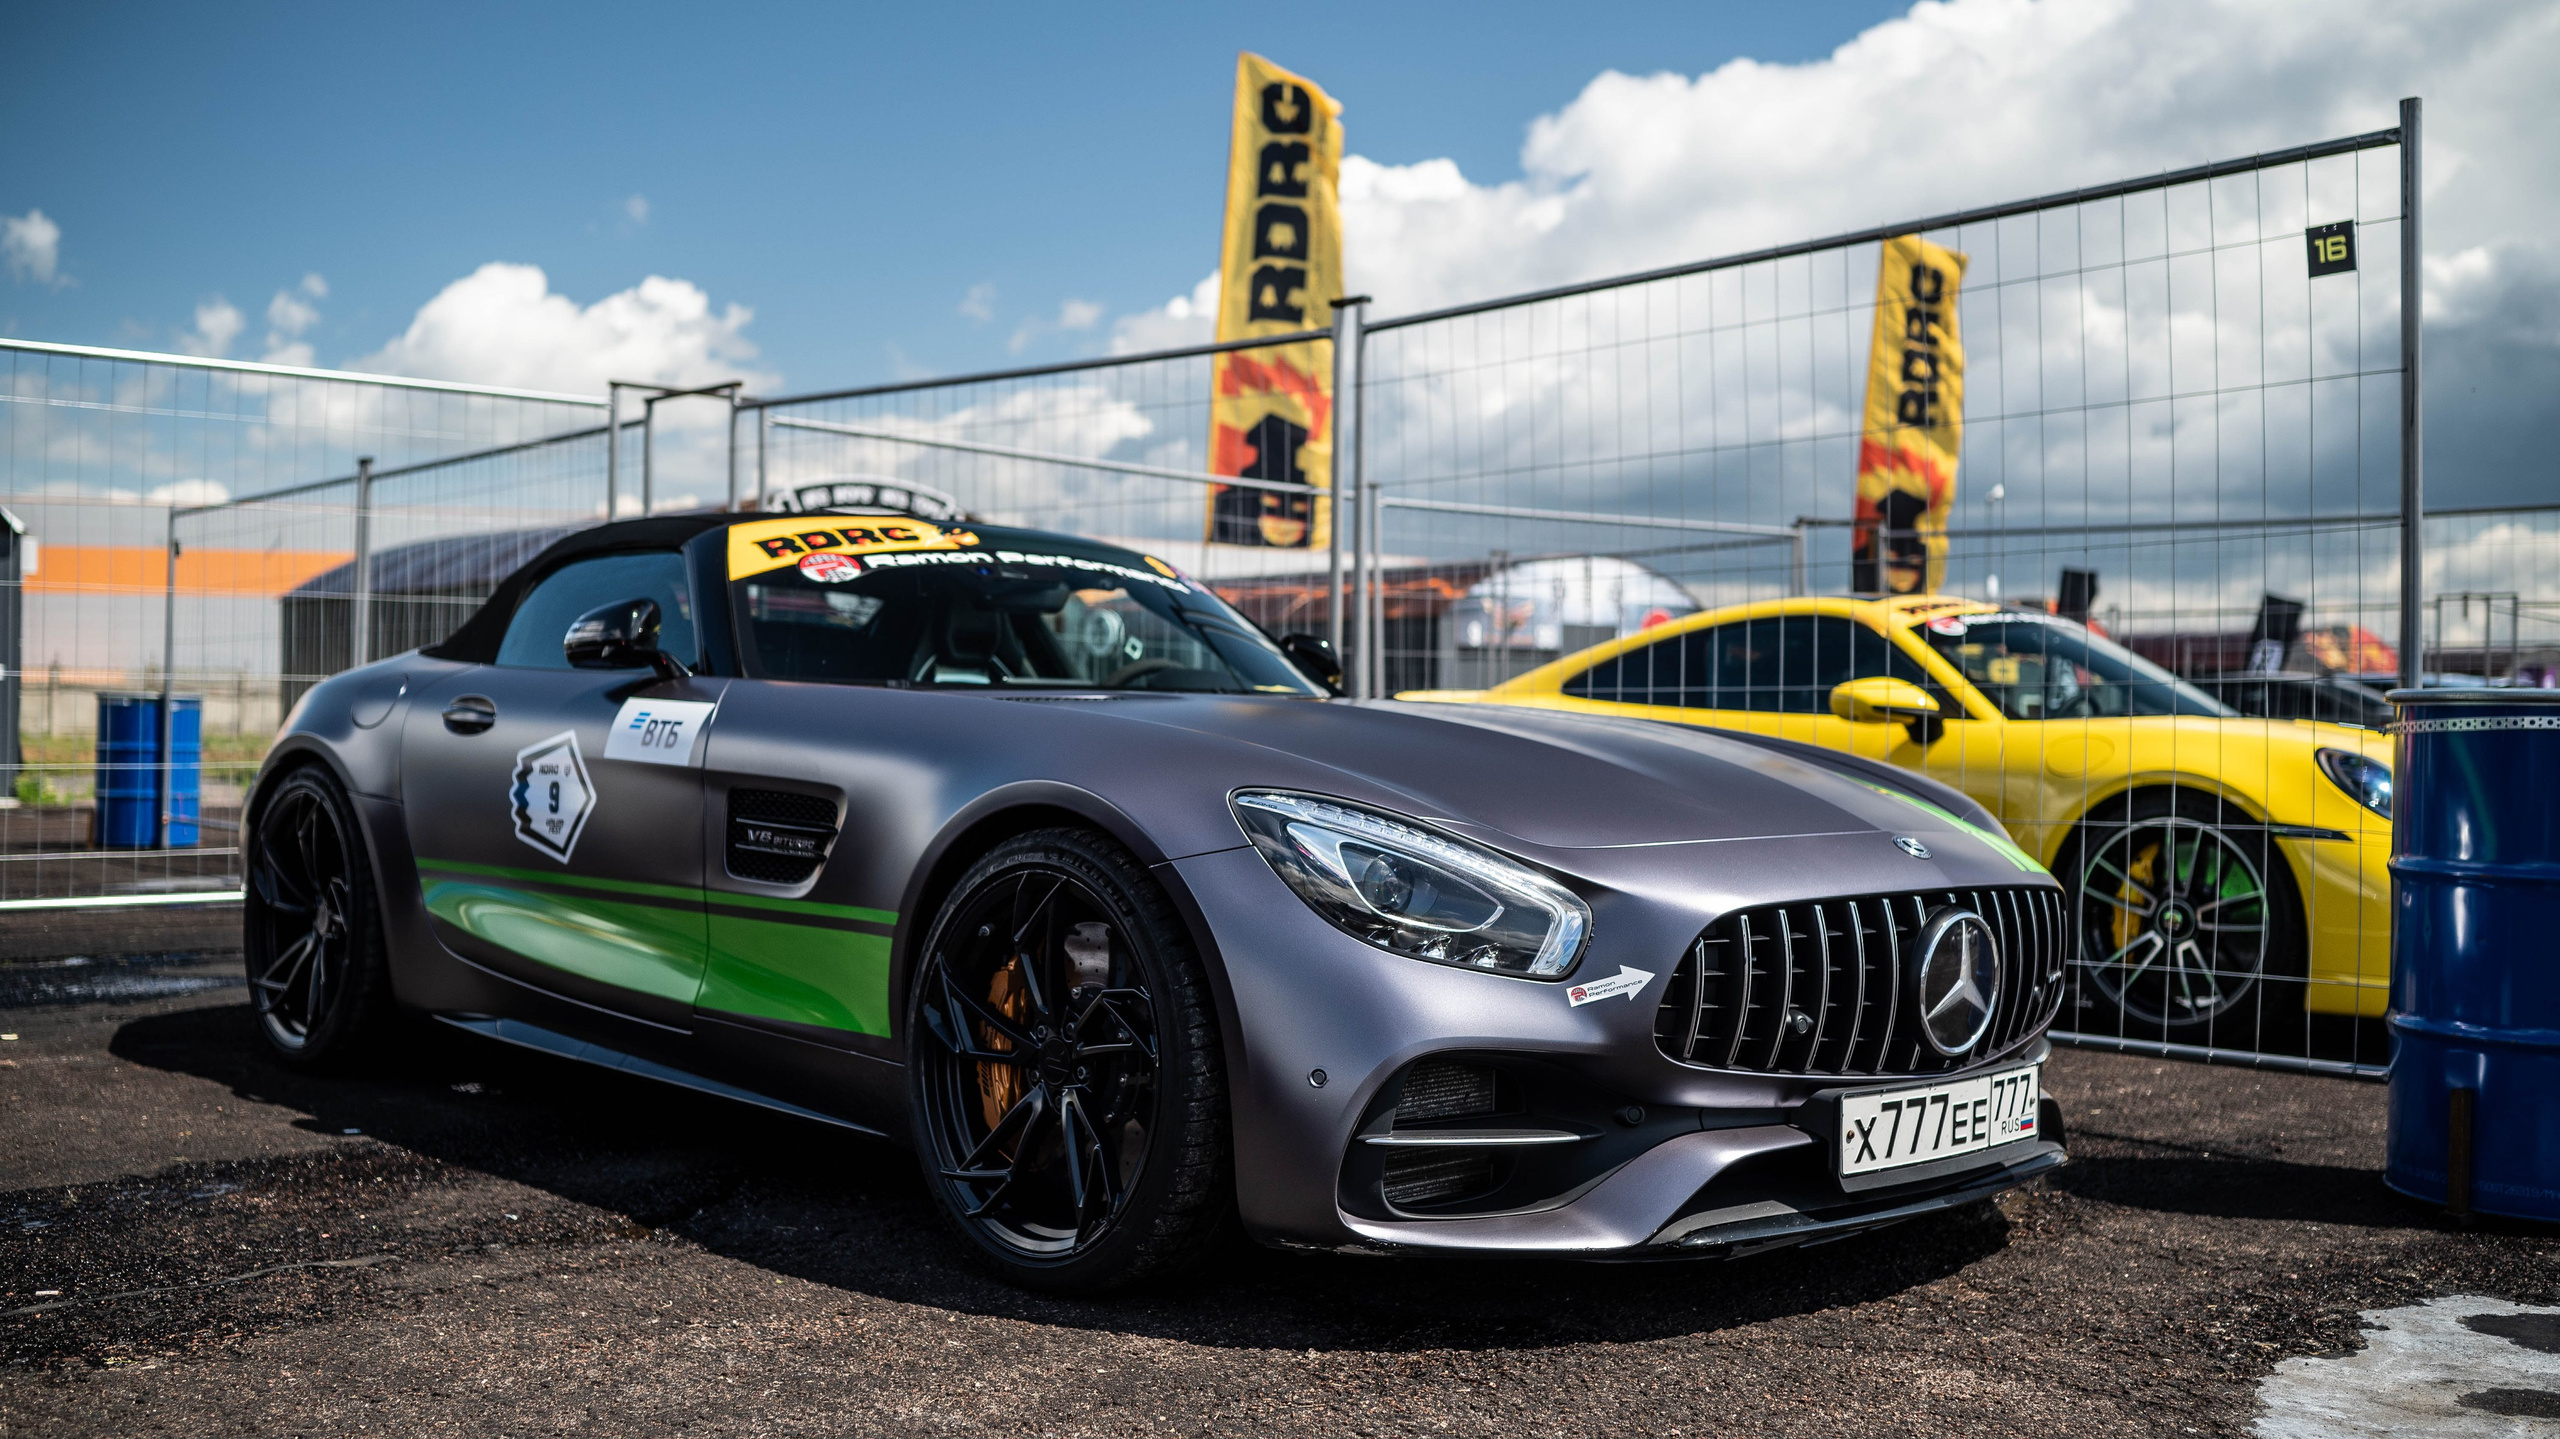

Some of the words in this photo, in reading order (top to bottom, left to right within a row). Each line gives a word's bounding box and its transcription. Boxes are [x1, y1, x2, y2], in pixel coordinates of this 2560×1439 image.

[1249, 82, 1311, 322] RDRC
[2315, 235, 2347, 263] 16
[1899, 263, 1943, 428] RDRC
[755, 527, 920, 558] RDRC
[864, 551, 994, 569] Ramon
[641, 719, 684, 750] ВТБ
[549, 780, 560, 814] 9
[1587, 981, 1616, 992] Ramon
[1588, 979, 1643, 998] Performance
[2001, 1117, 2020, 1136] RUS
